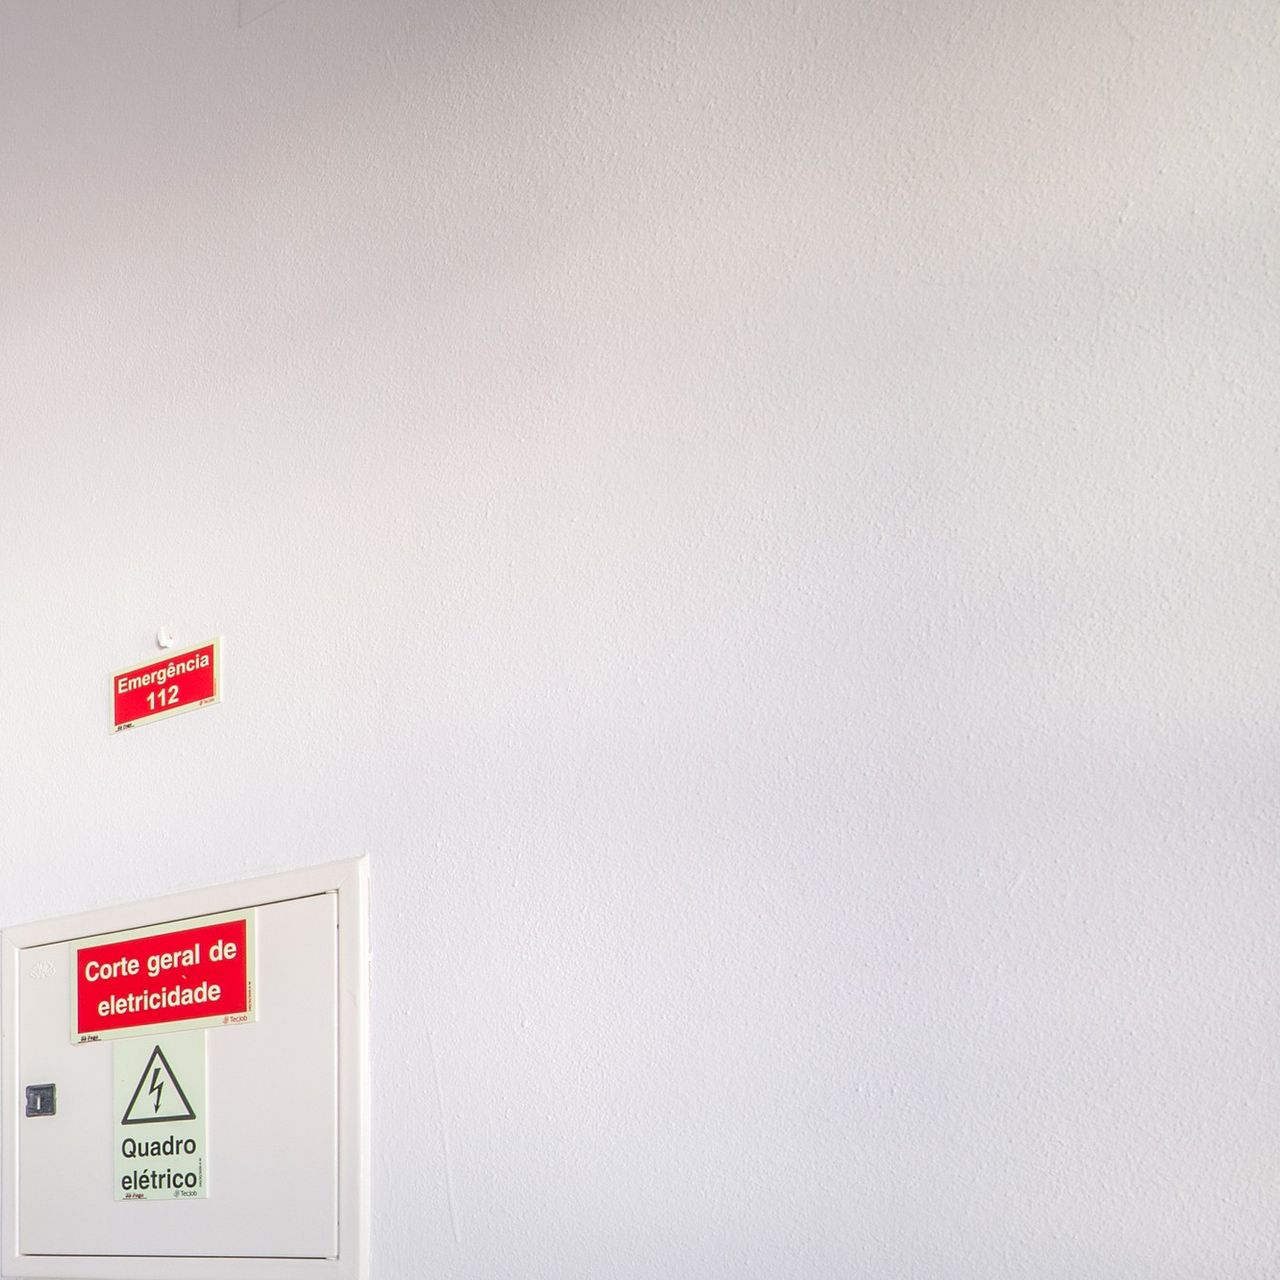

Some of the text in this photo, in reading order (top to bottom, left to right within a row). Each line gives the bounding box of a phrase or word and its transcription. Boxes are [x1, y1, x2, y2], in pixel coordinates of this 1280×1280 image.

[118, 653, 209, 694] Emergência
[146, 684, 179, 710] 112
[85, 939, 237, 982] Corte geral de
[98, 981, 221, 1017] eletricidade
[121, 1135, 196, 1158] Quadro
[121, 1168, 197, 1190] elétrico
